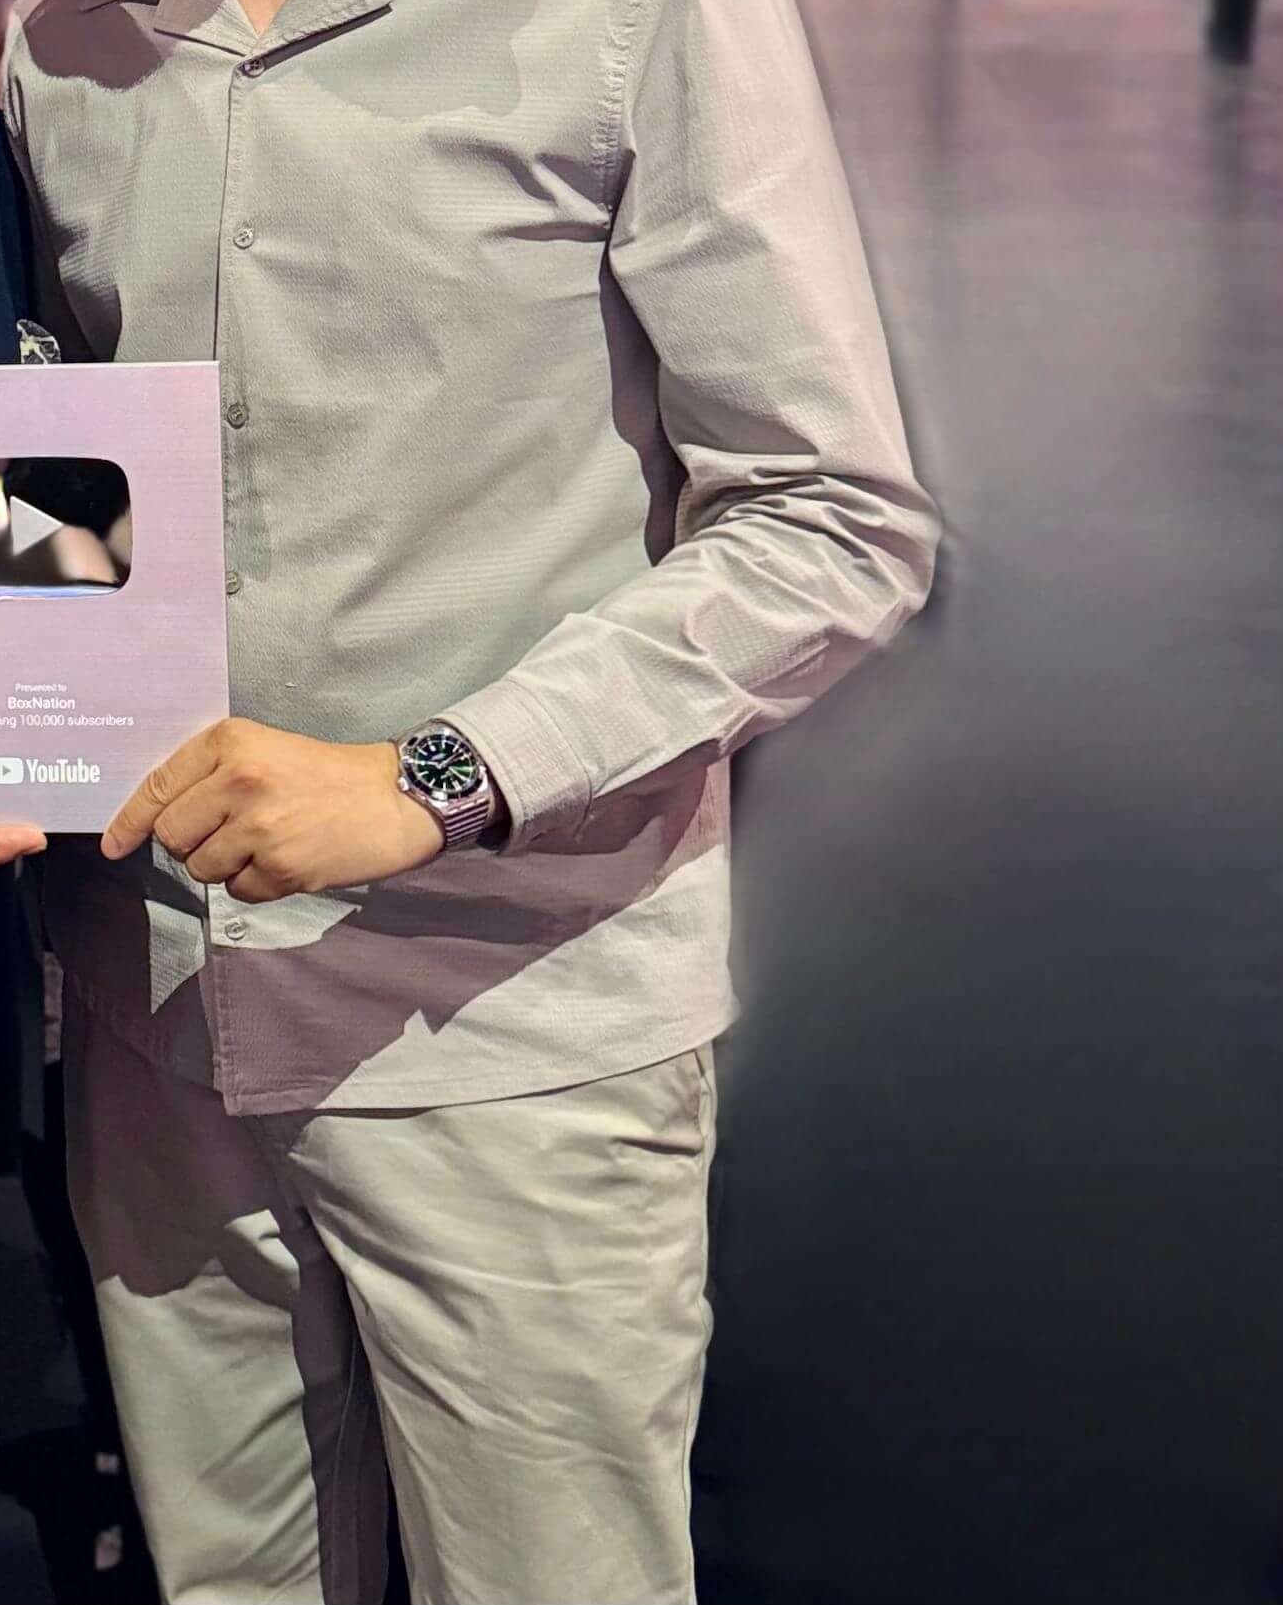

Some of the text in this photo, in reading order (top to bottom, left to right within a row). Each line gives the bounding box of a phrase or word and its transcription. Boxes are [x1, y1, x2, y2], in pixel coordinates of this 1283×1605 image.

[15, 683, 67, 692] Presented to
[8, 697, 76, 710] BoxNation
[20, 715, 65, 729] 100,000
[67, 714, 134, 727] subscribers
[26, 758, 101, 784] YouTube
